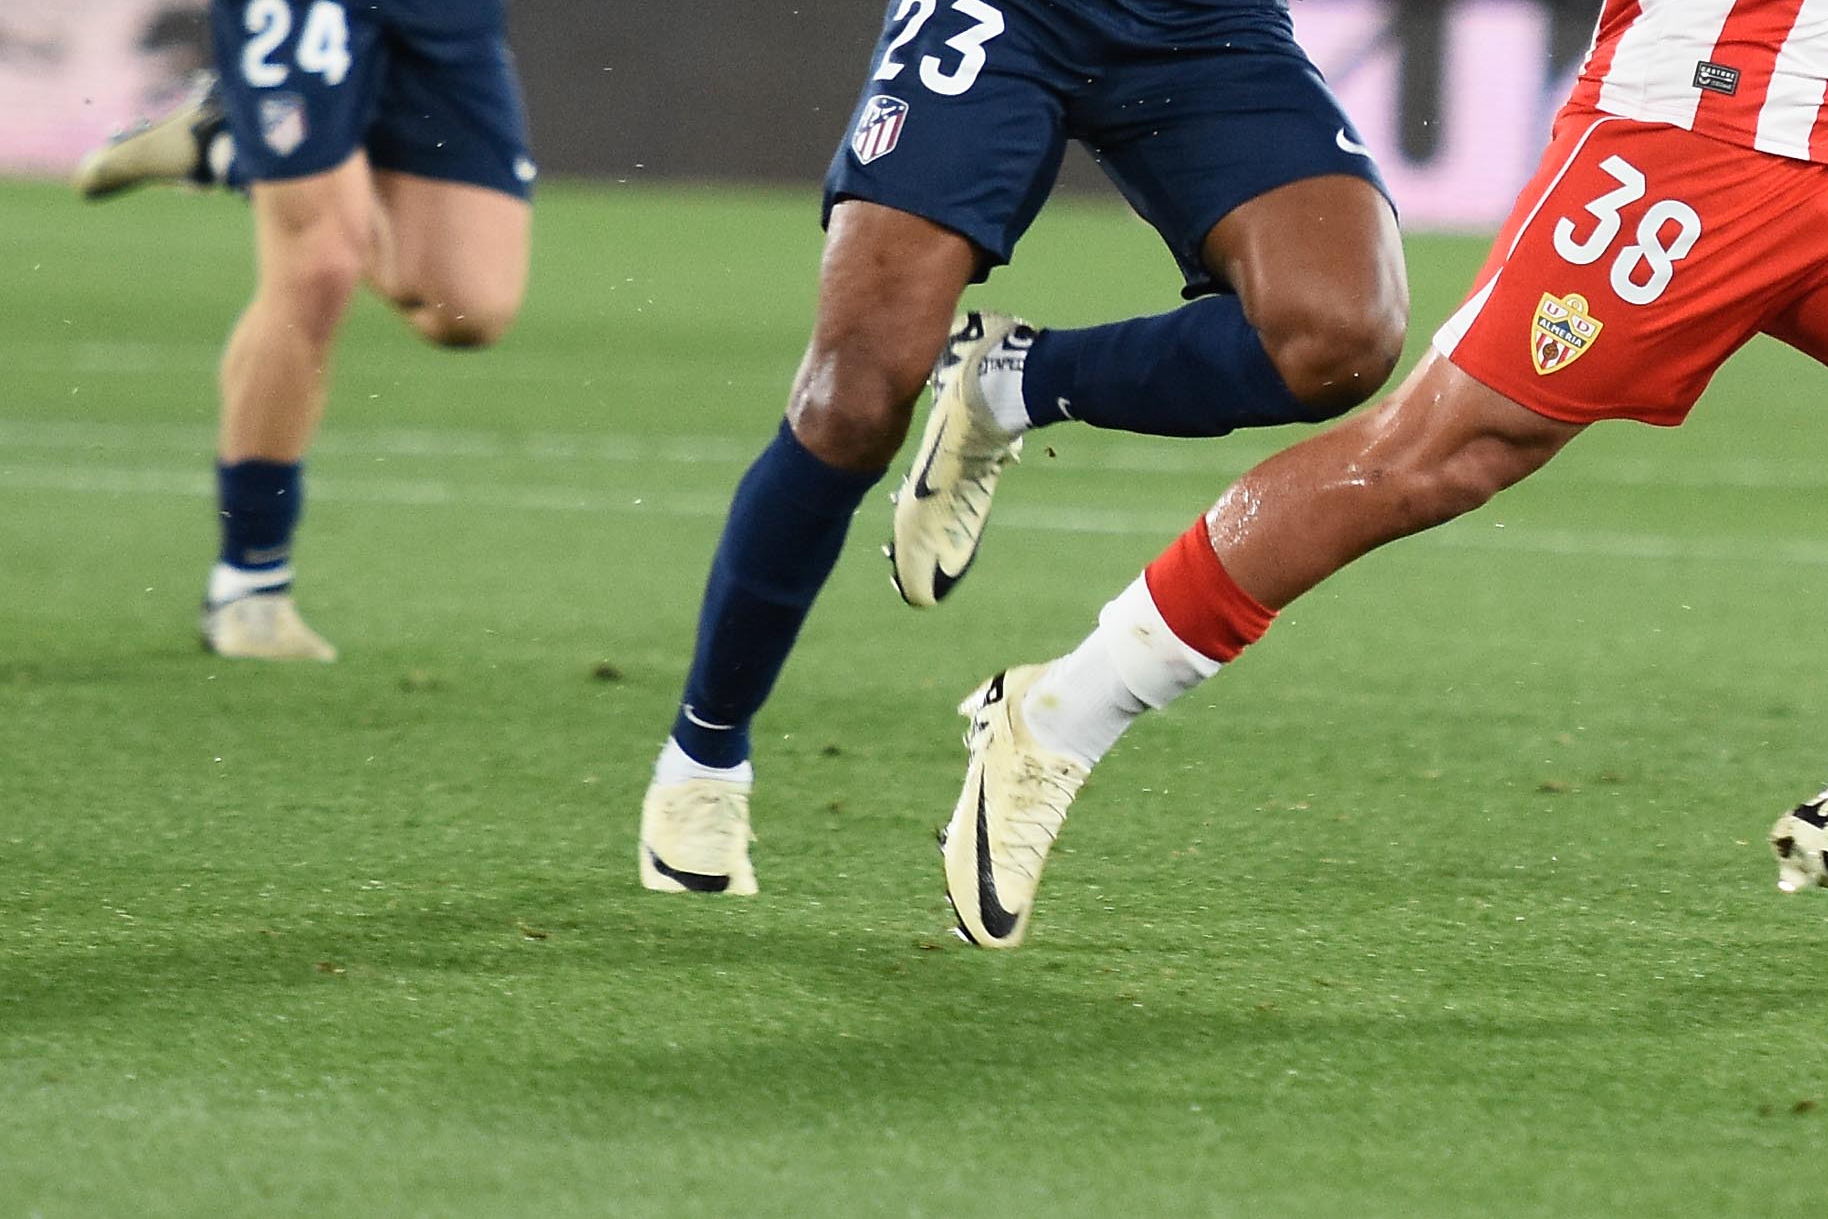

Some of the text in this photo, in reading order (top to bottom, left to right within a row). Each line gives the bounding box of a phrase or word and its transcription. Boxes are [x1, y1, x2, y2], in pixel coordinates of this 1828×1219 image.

[1553, 154, 1702, 305] 38
[1539, 318, 1582, 347] ALMERIA
[1546, 302, 1590, 333] U D
